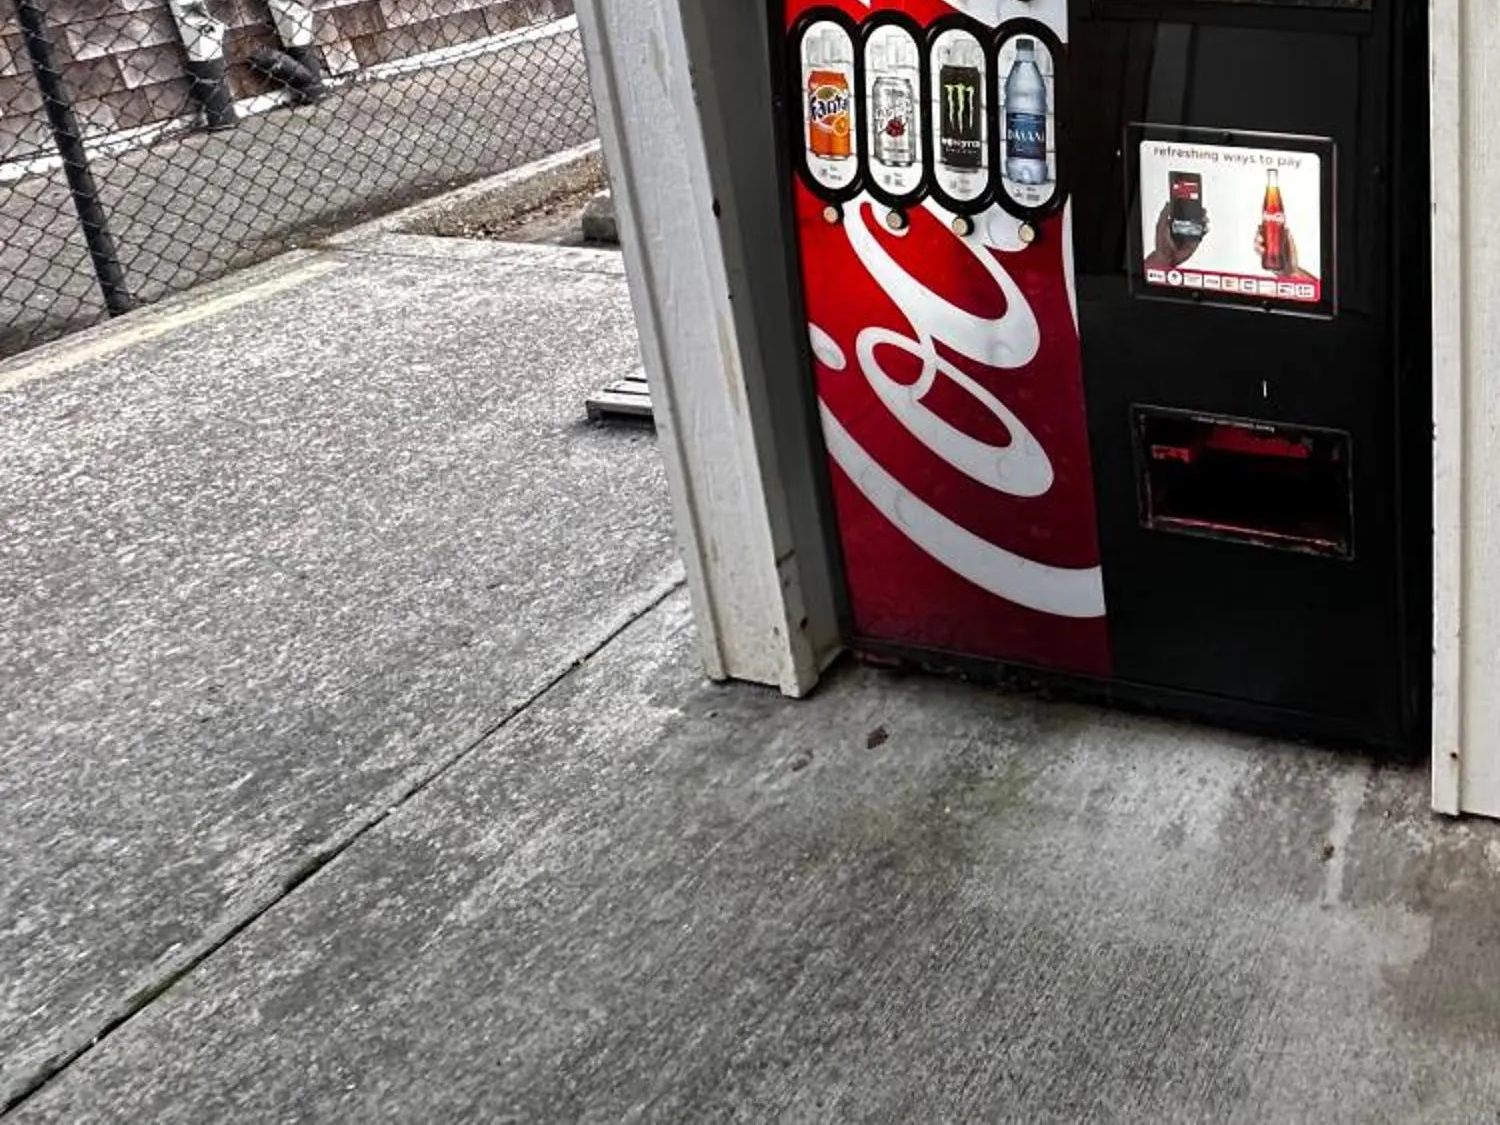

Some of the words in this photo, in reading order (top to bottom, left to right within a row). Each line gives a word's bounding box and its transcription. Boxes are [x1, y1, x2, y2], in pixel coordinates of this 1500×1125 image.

[1153, 145, 1219, 162] refreshing
[1223, 152, 1257, 164] ways
[1259, 154, 1273, 166] to
[1277, 156, 1303, 169] pay
